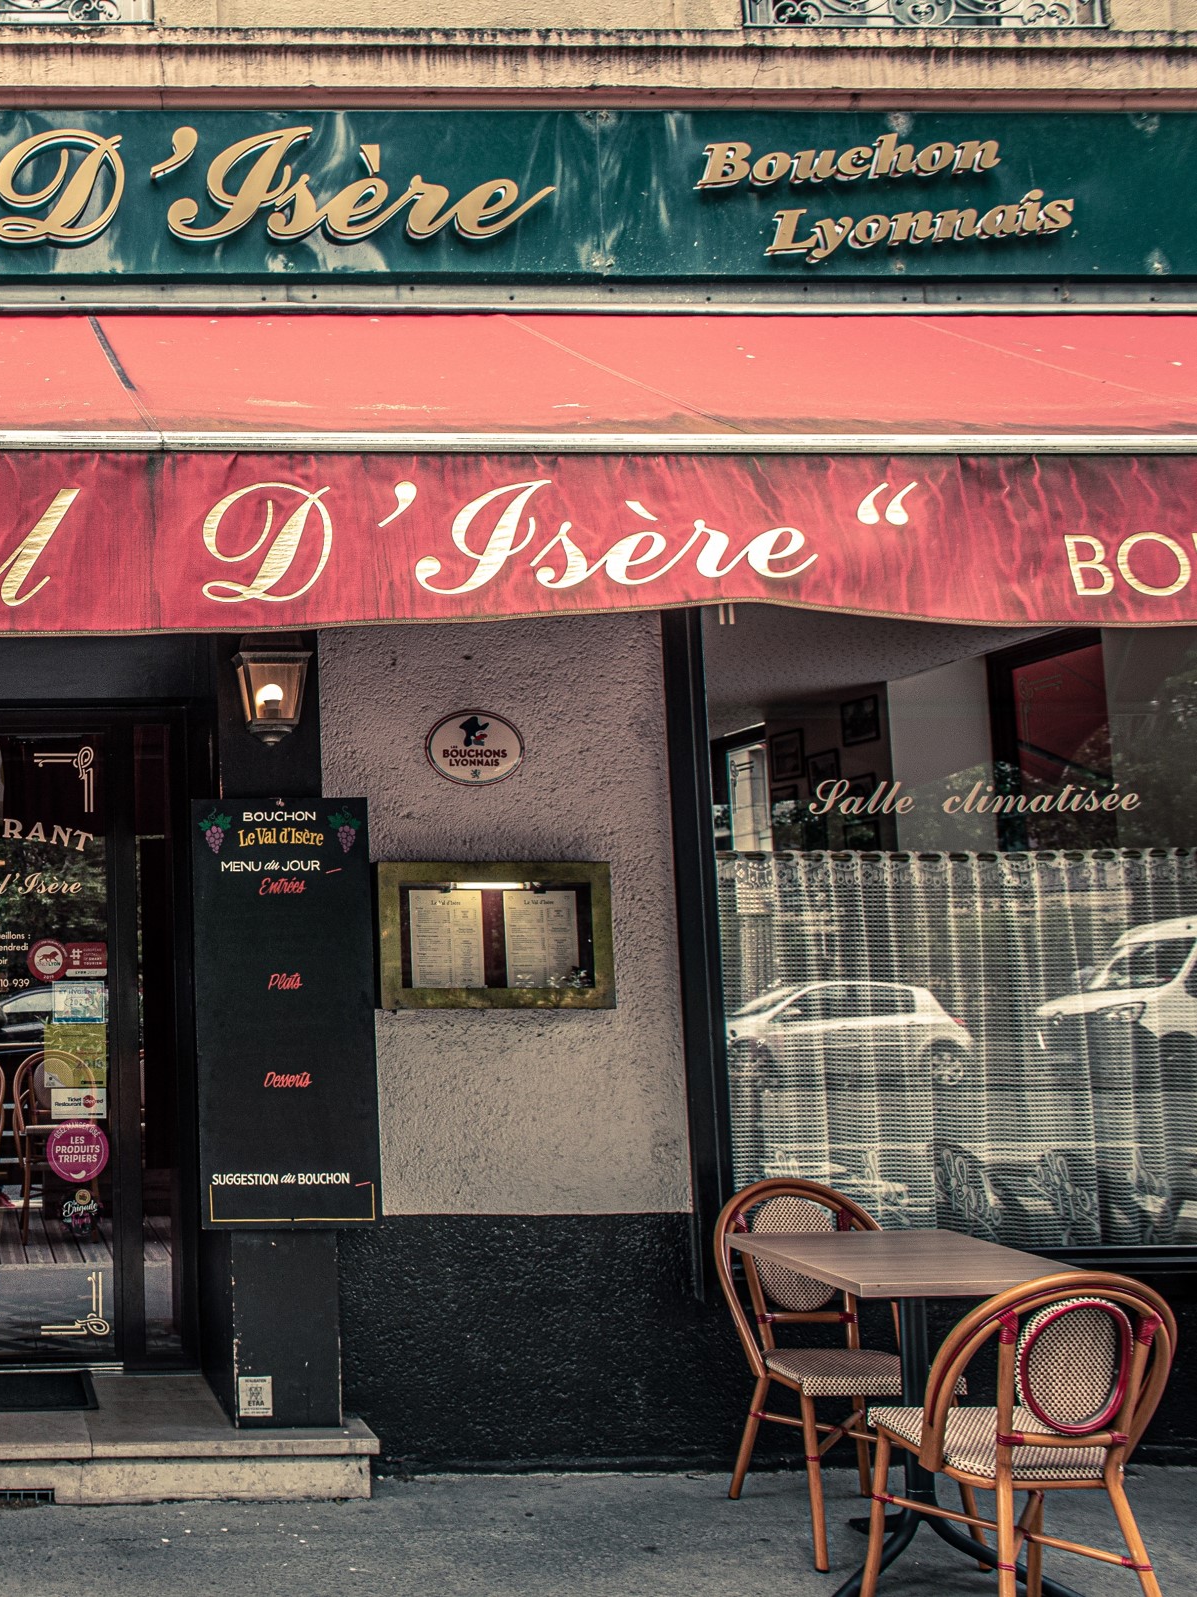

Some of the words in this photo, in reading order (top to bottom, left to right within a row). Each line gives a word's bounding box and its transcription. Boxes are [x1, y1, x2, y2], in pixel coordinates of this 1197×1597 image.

[695, 132, 1001, 190] Bouchon
[764, 188, 1074, 263] Lyonnais
[1063, 531, 1197, 597] BO
[443, 749, 508, 758] BOUCHONS
[449, 759, 500, 767] LYONNAIS
[808, 779, 915, 815] Salle
[942, 781, 1141, 813] climatisée
[243, 811, 316, 822] BOUCHON
[238, 829, 255, 847] Le
[255, 828, 277, 845] Val
[279, 827, 324, 847] d'Isère
[221, 861, 261, 872] MENU
[264, 859, 280, 871] du
[281, 860, 320, 871] JOUR
[259, 877, 306, 895] Entrées
[12, 978, 30, 988] 939
[268, 973, 302, 990] Plats
[264, 1071, 312, 1088] Desserts
[55, 1145, 100, 1153] PRODUITS
[58, 1154, 97, 1162] TRIPIERS
[212, 1173, 278, 1185] SUGGESTION
[280, 1173, 296, 1184] du
[298, 1172, 350, 1185] BOUCHON
